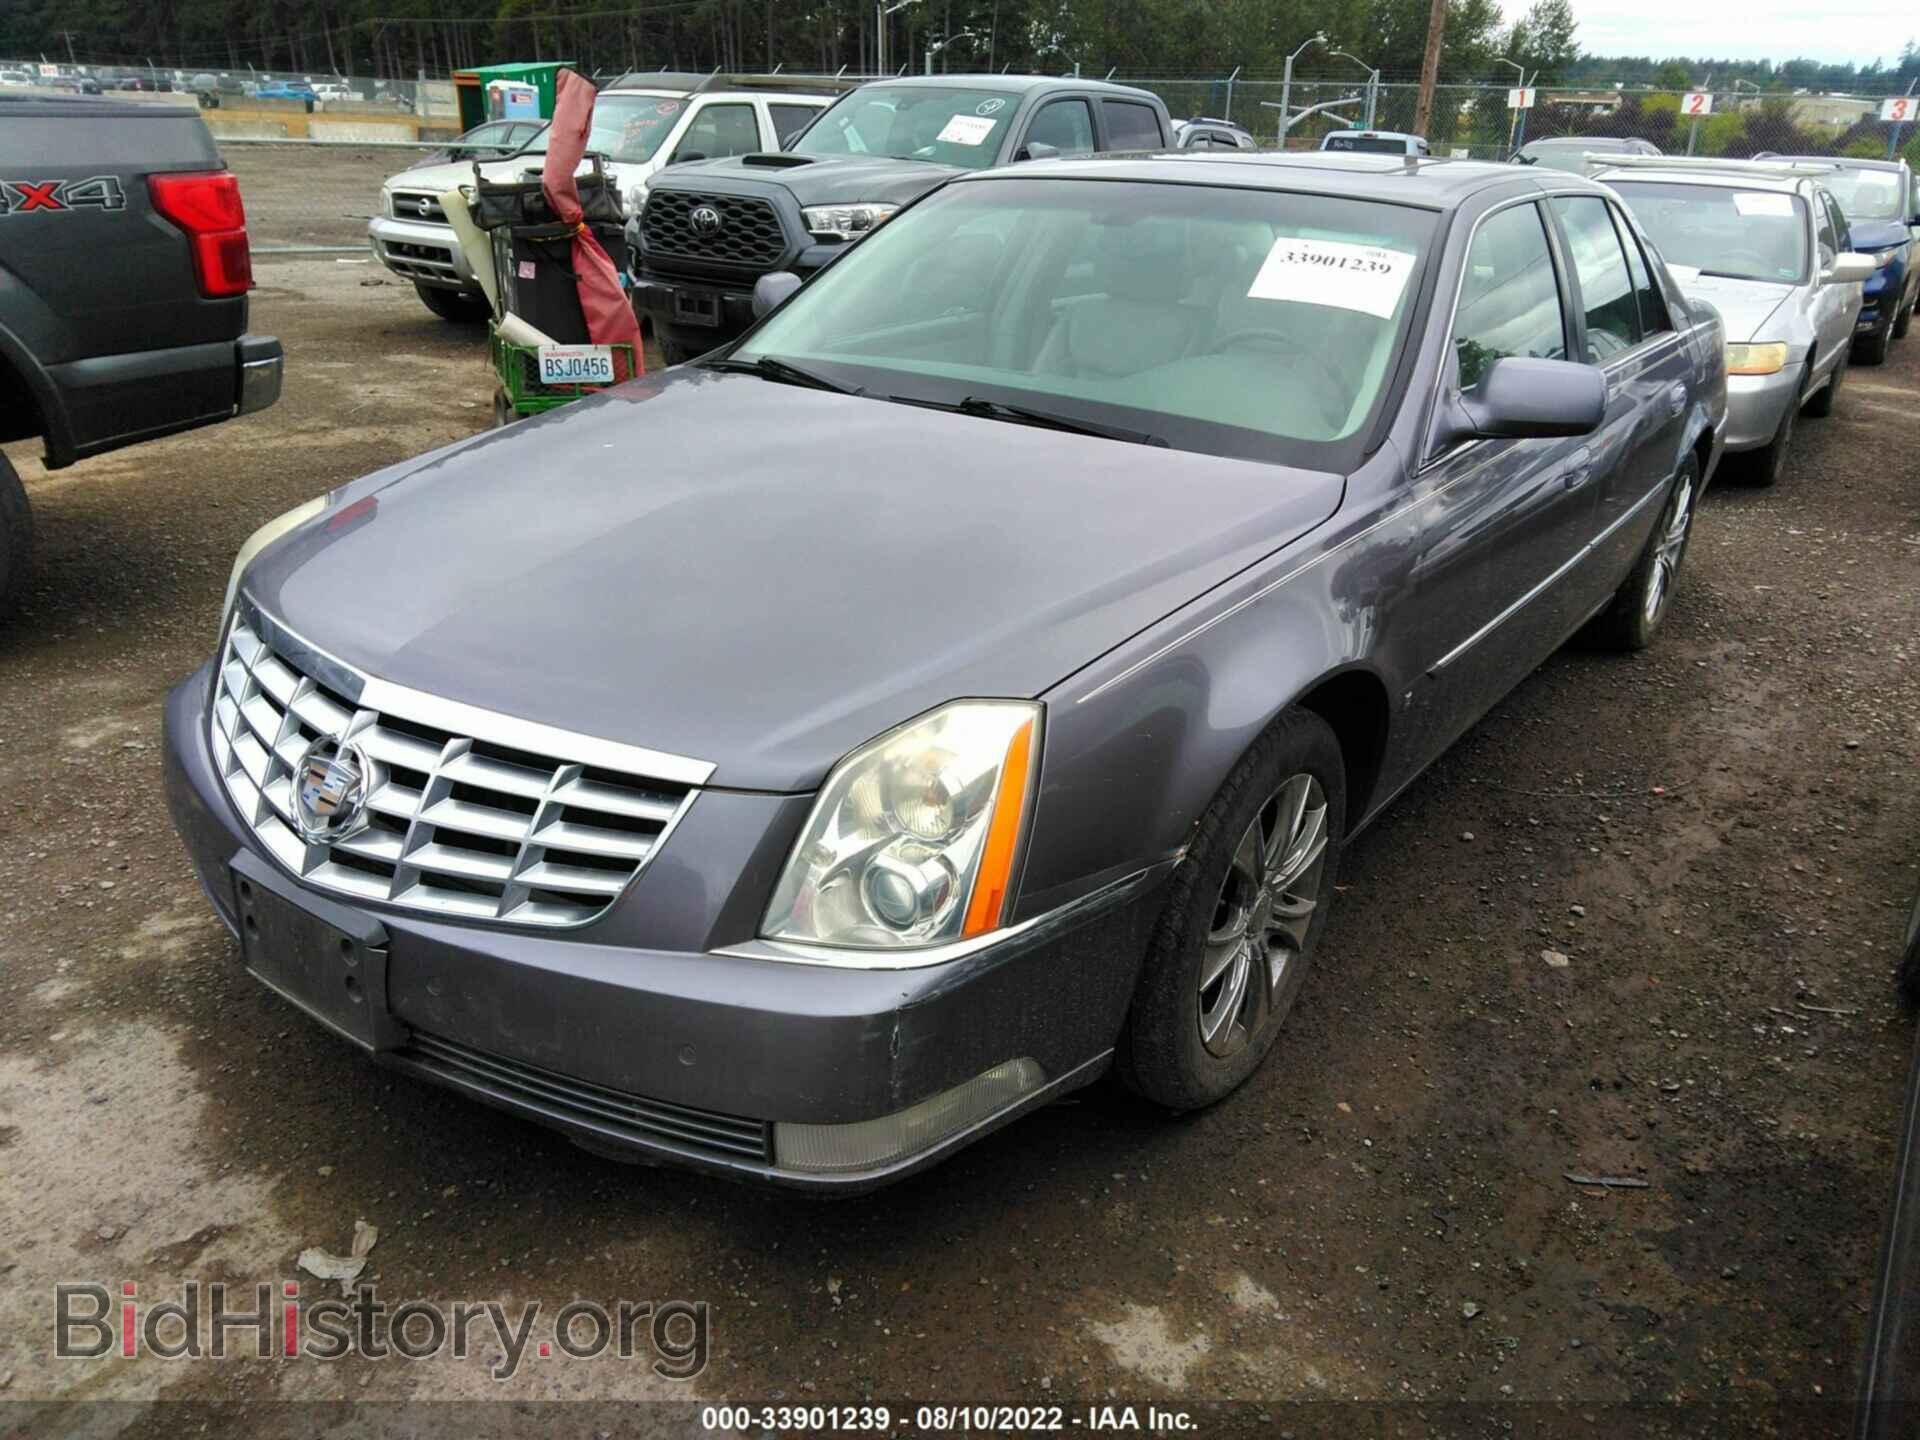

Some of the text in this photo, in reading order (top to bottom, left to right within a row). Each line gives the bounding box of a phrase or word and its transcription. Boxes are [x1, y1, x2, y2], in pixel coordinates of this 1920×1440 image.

[1519, 90, 1526, 106] 1
[1691, 95, 1705, 113] 2
[1891, 100, 1907, 120] 3
[0, 176, 127, 216] X4
[1280, 251, 1392, 275] 33901239
[545, 357, 609, 377] BSJ0456
